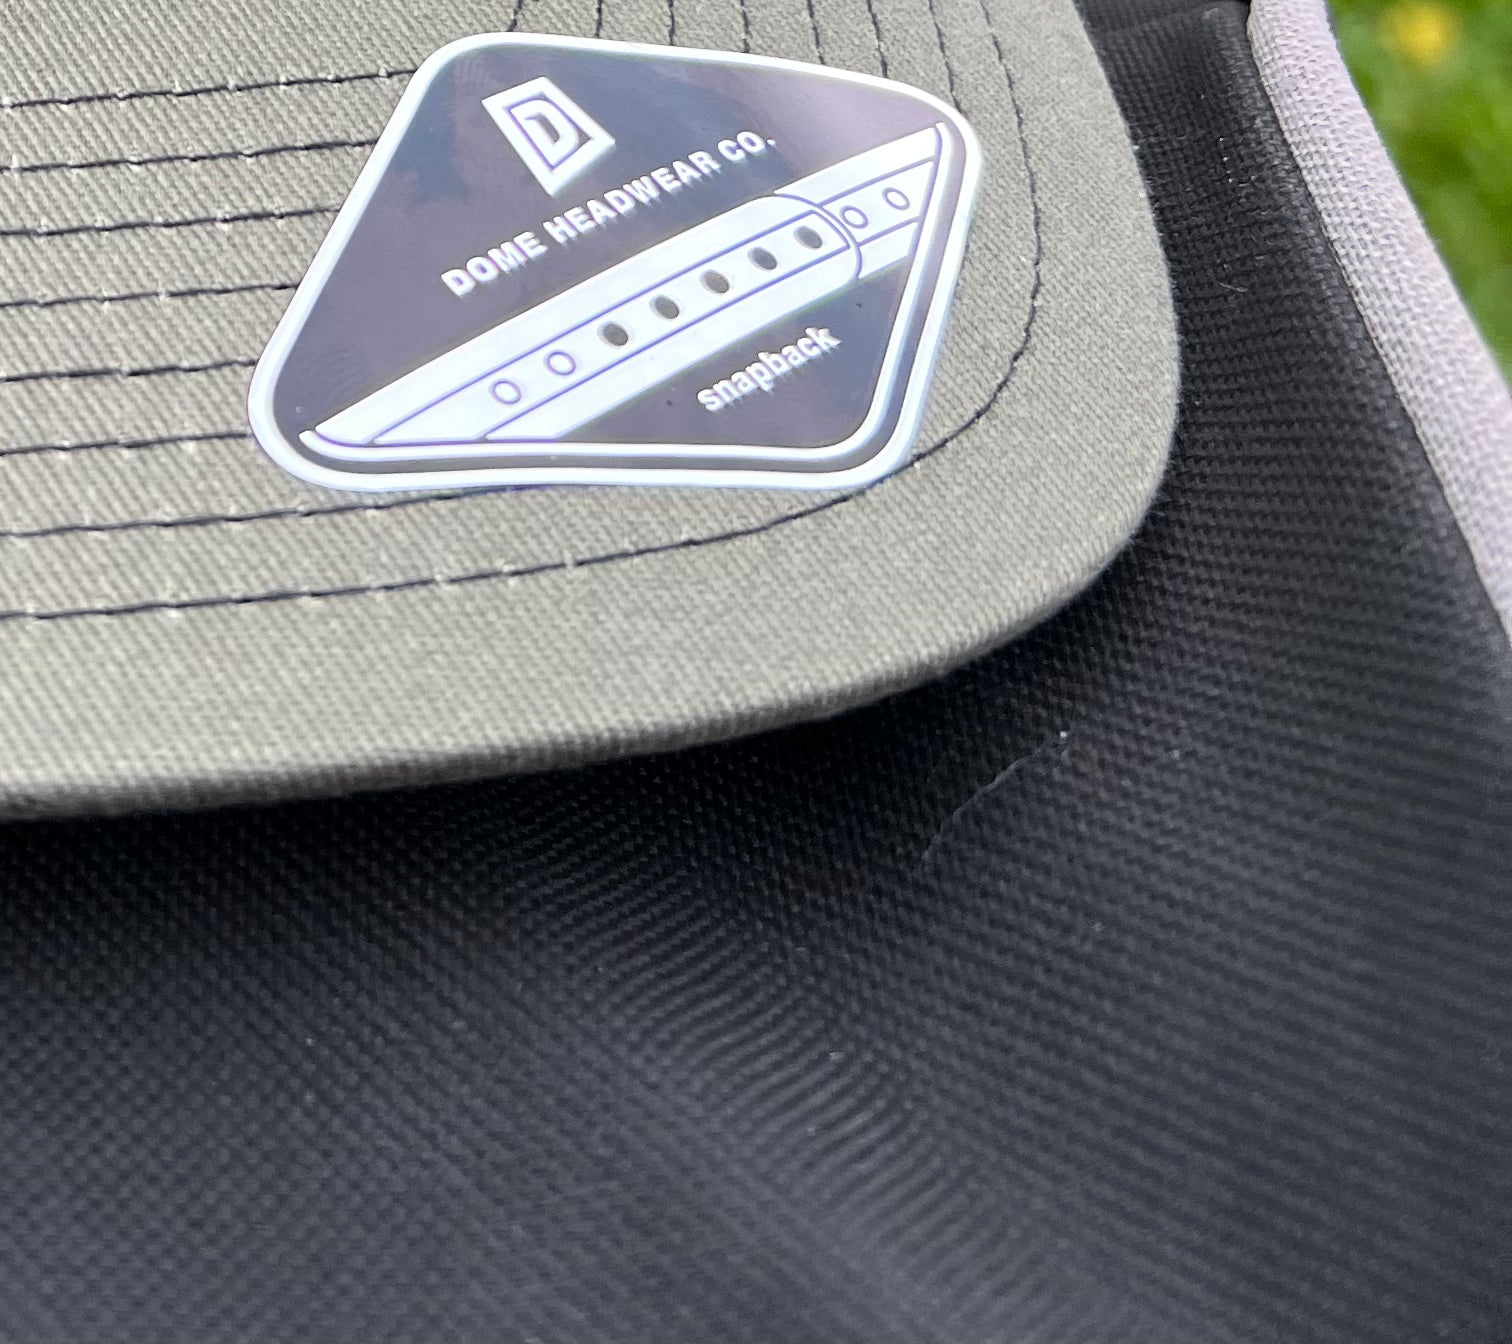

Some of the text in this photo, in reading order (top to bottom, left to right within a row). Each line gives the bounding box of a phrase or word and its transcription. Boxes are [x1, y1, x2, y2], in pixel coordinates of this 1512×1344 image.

[440, 130, 777, 297] DOME HEADWEAR CO.
[697, 326, 842, 413] snapback
